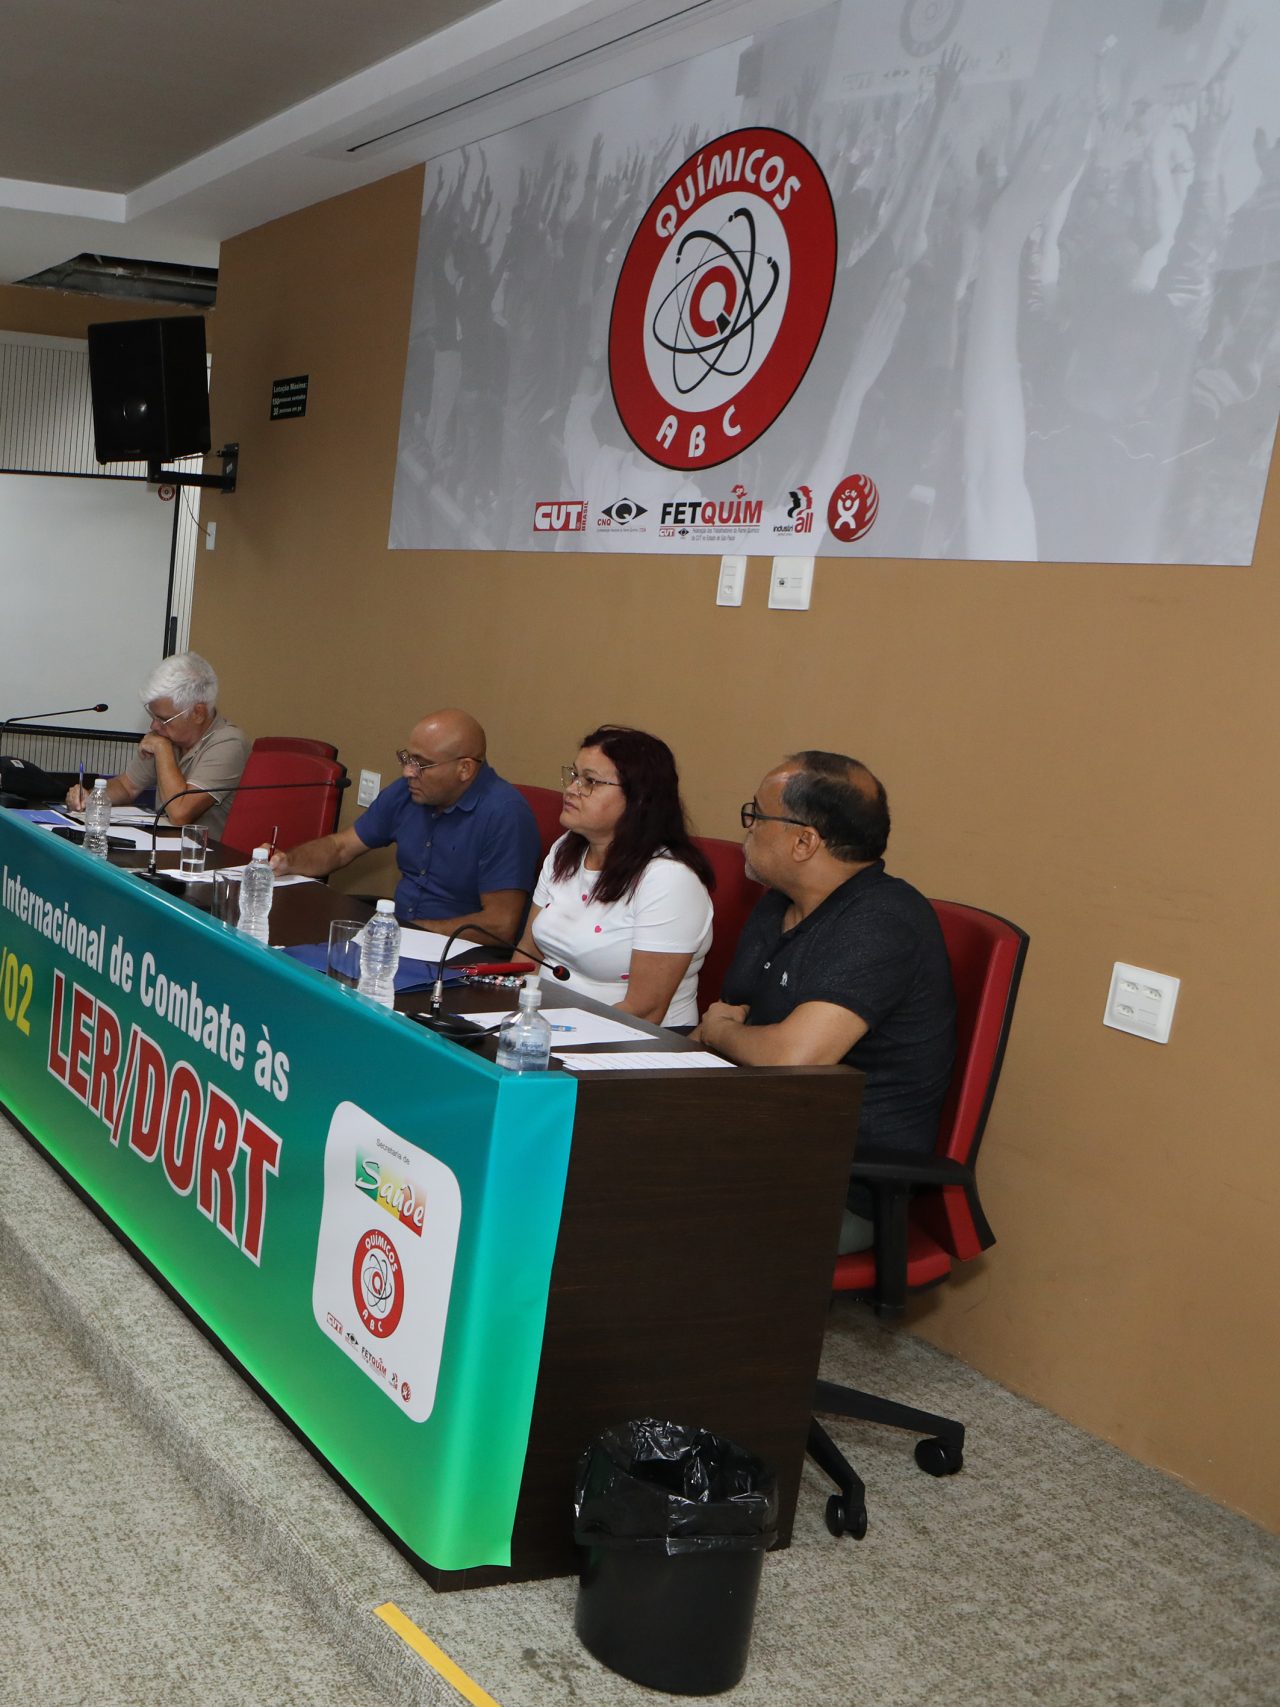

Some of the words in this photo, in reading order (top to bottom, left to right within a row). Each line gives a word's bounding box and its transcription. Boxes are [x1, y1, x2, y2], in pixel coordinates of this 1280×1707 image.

[656, 147, 801, 239] QUÍMICOS
[534, 504, 582, 530] CUT
[597, 518, 611, 526] CNQ
[660, 500, 763, 526] FETQUIM
[2, 865, 106, 974] Internacional
[109, 935, 134, 993] de
[140, 951, 246, 1071] Combate
[254, 1023, 290, 1102] às
[47, 967, 283, 1269] LER/DORT
[355, 1159, 424, 1227] Saúde
[365, 1231, 399, 1273] QUÍMICOS
